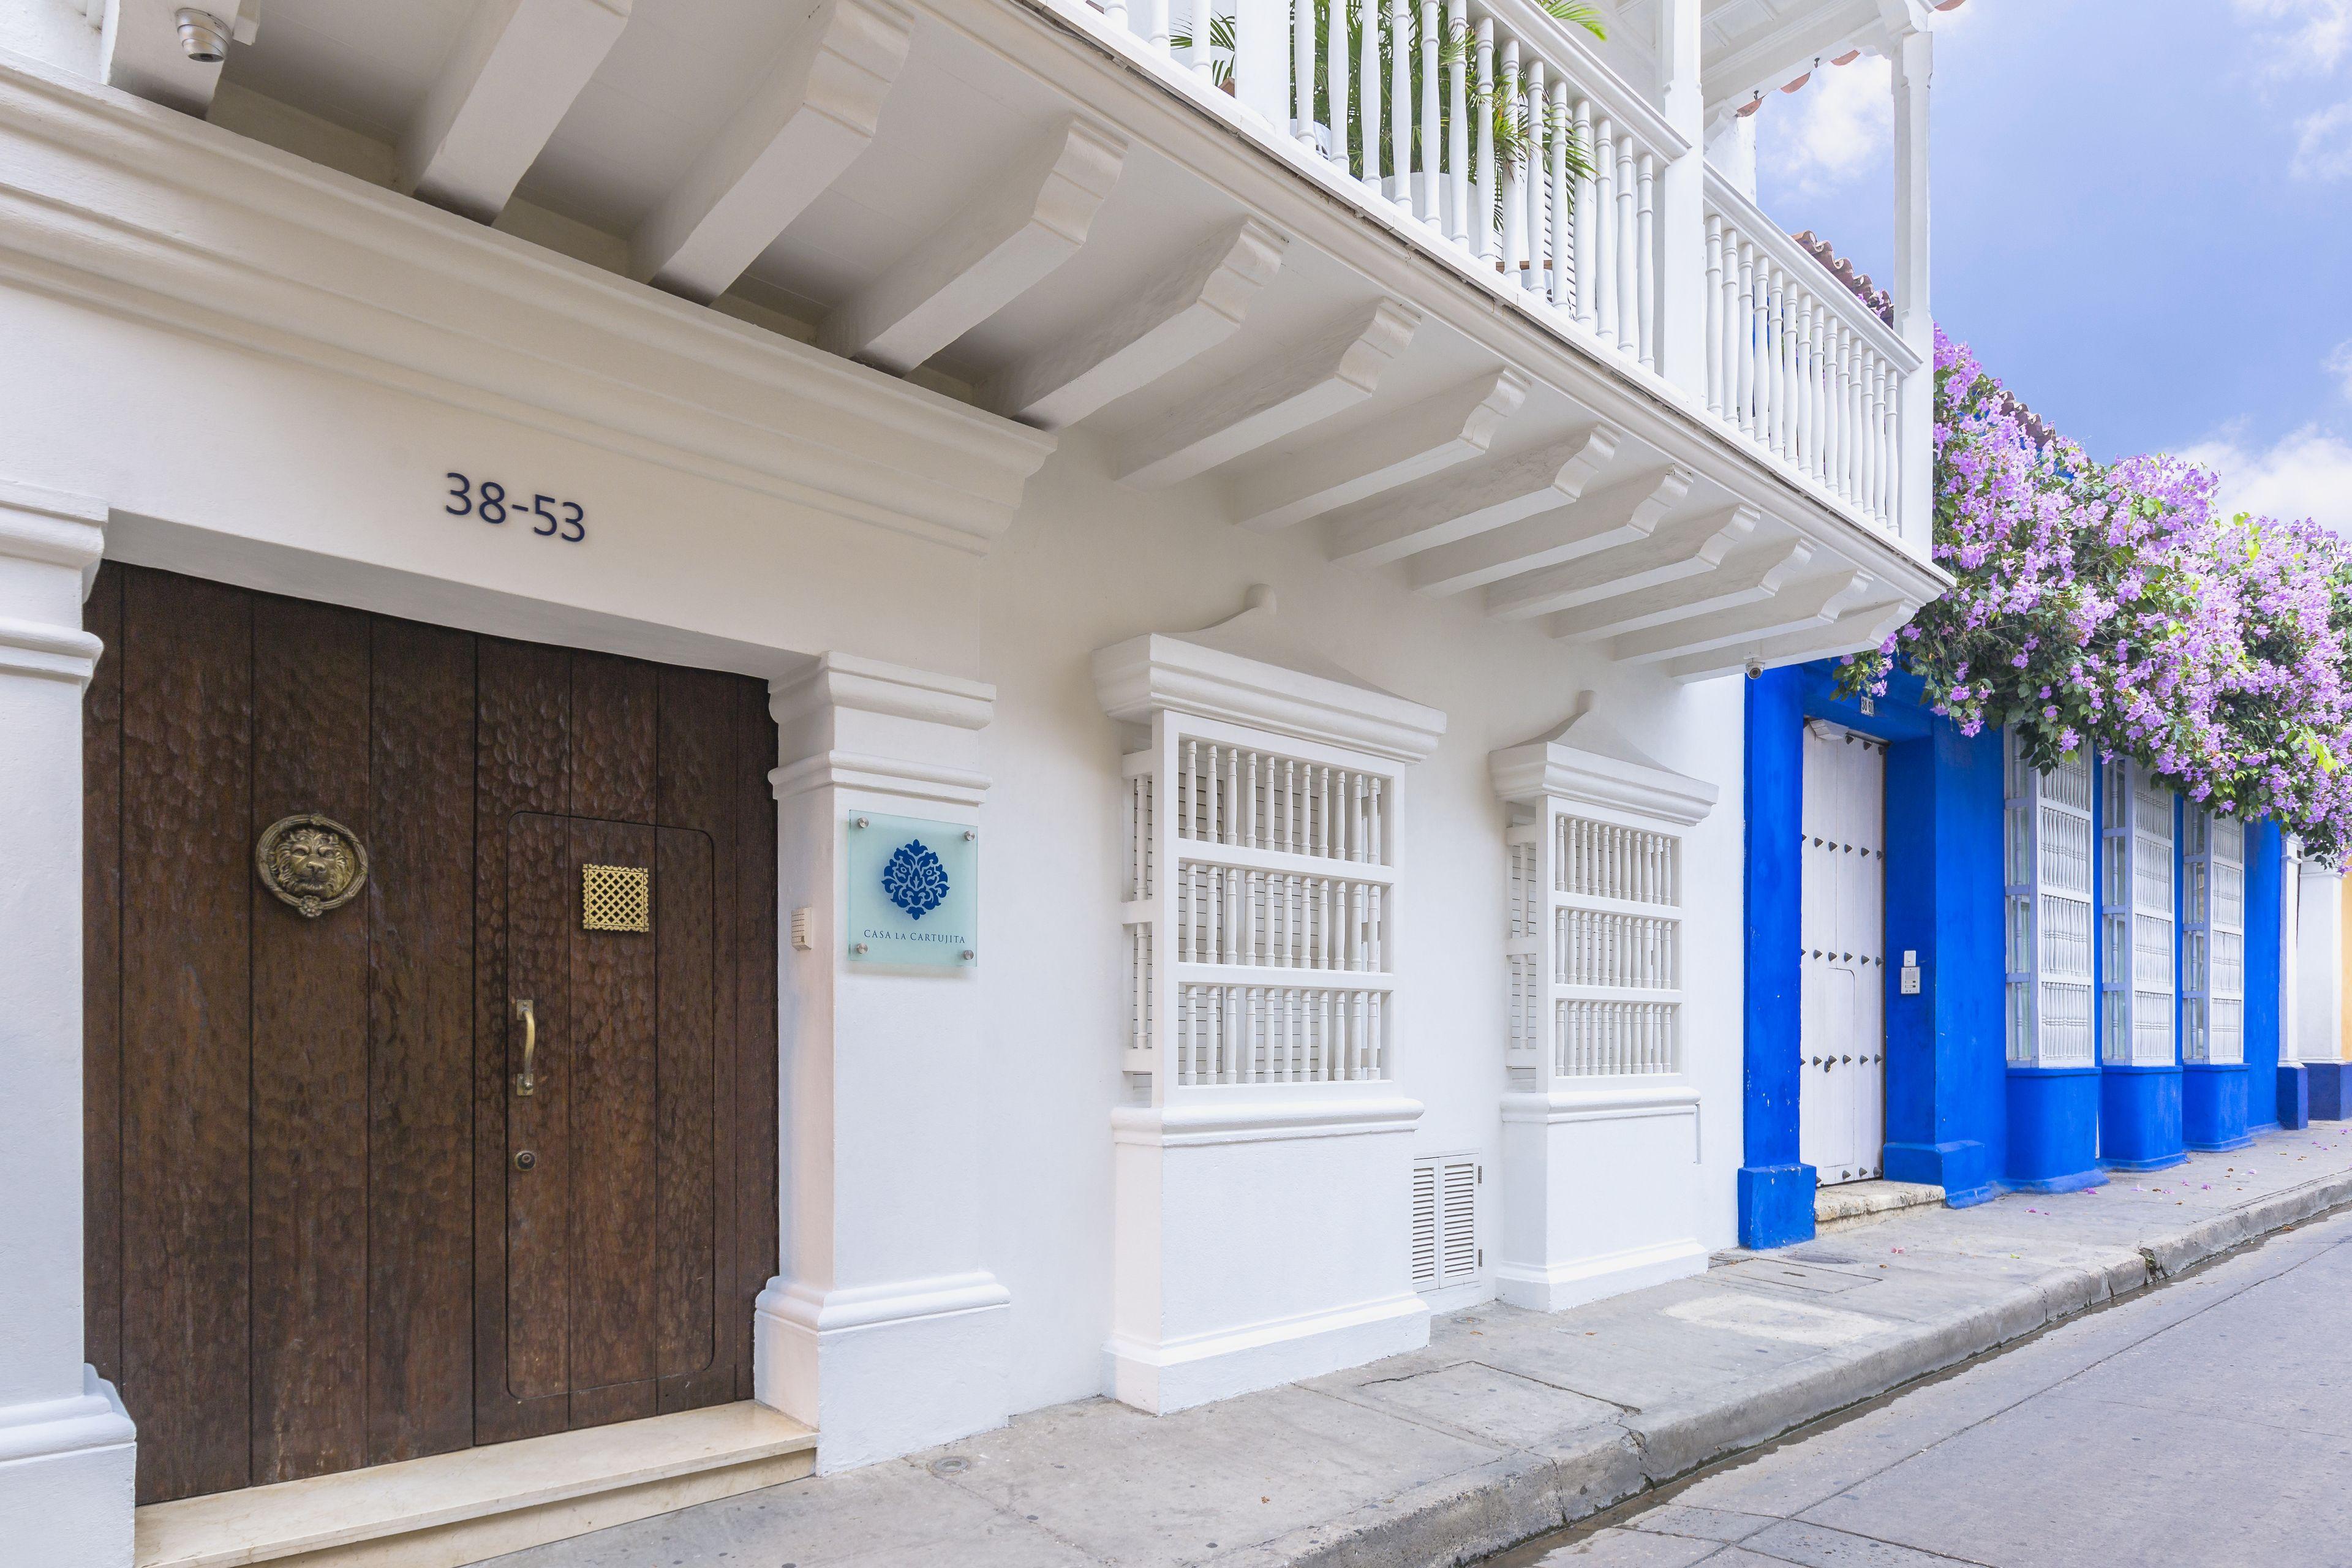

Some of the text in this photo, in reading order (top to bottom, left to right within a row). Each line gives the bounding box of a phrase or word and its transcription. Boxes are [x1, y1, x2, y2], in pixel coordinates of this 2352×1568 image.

[446, 472, 585, 542] 38-53
[864, 929, 891, 939] CASA
[910, 932, 965, 944] CARTUJITA
